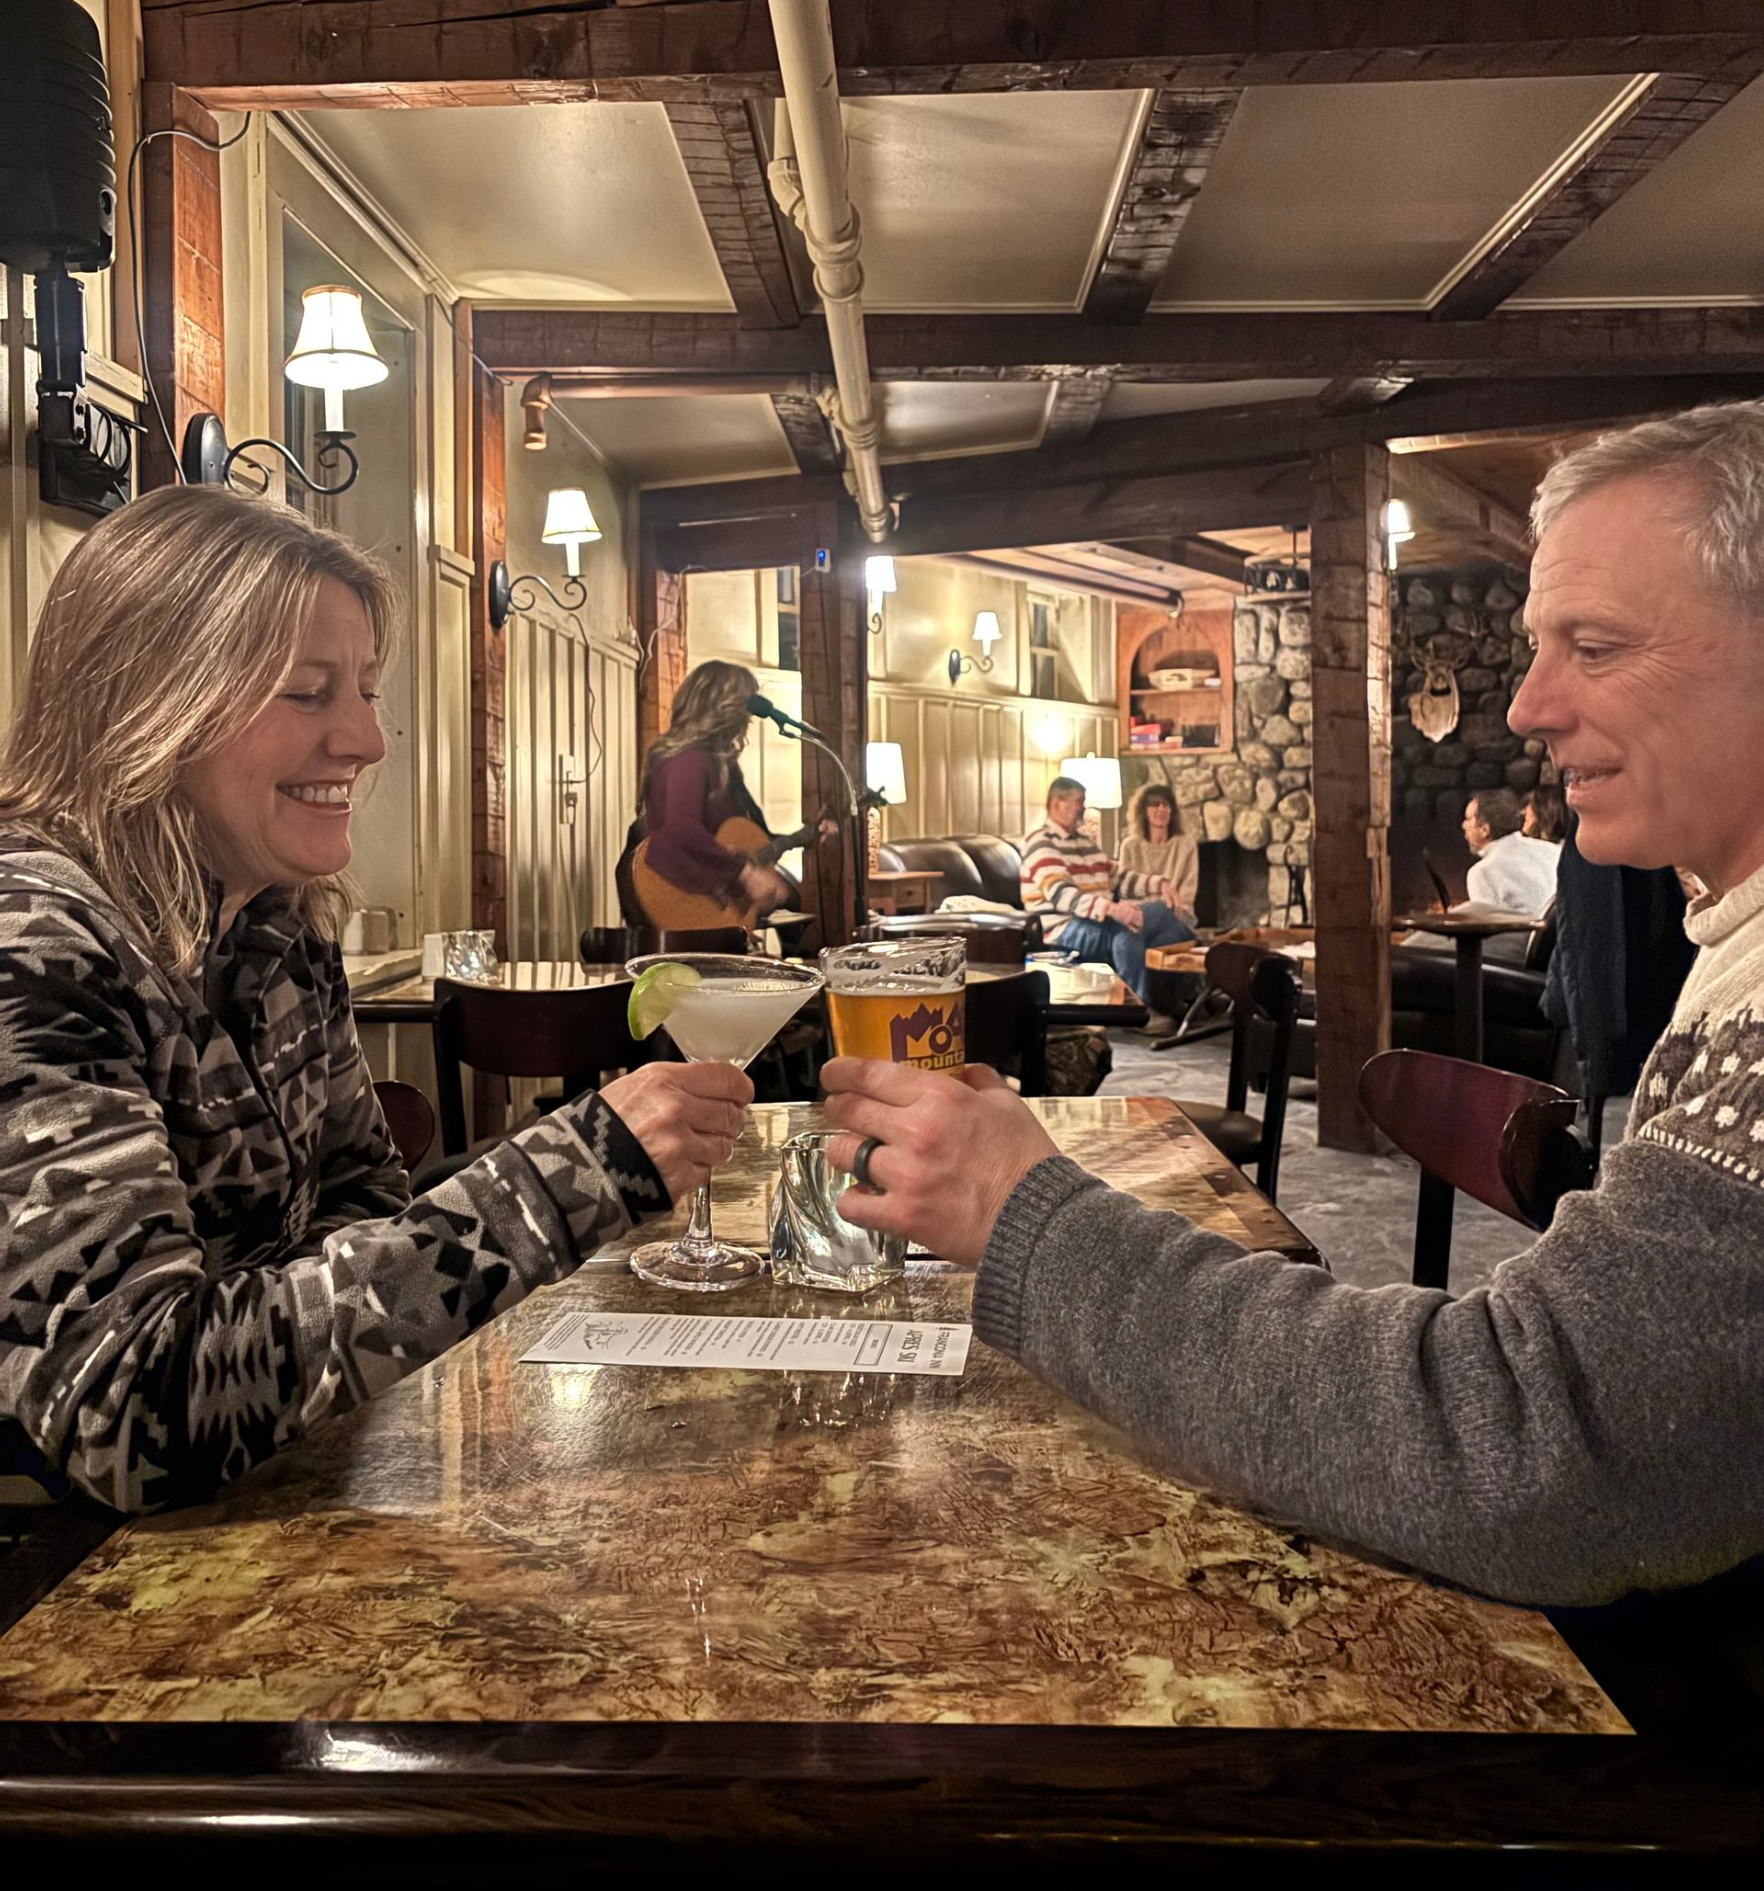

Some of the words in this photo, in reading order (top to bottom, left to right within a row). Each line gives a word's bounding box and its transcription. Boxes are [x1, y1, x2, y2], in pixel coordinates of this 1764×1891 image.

[931, 1331, 950, 1359] FRANCONIA
[897, 1352, 918, 1363] SKI
[928, 1359, 941, 1369] INN
